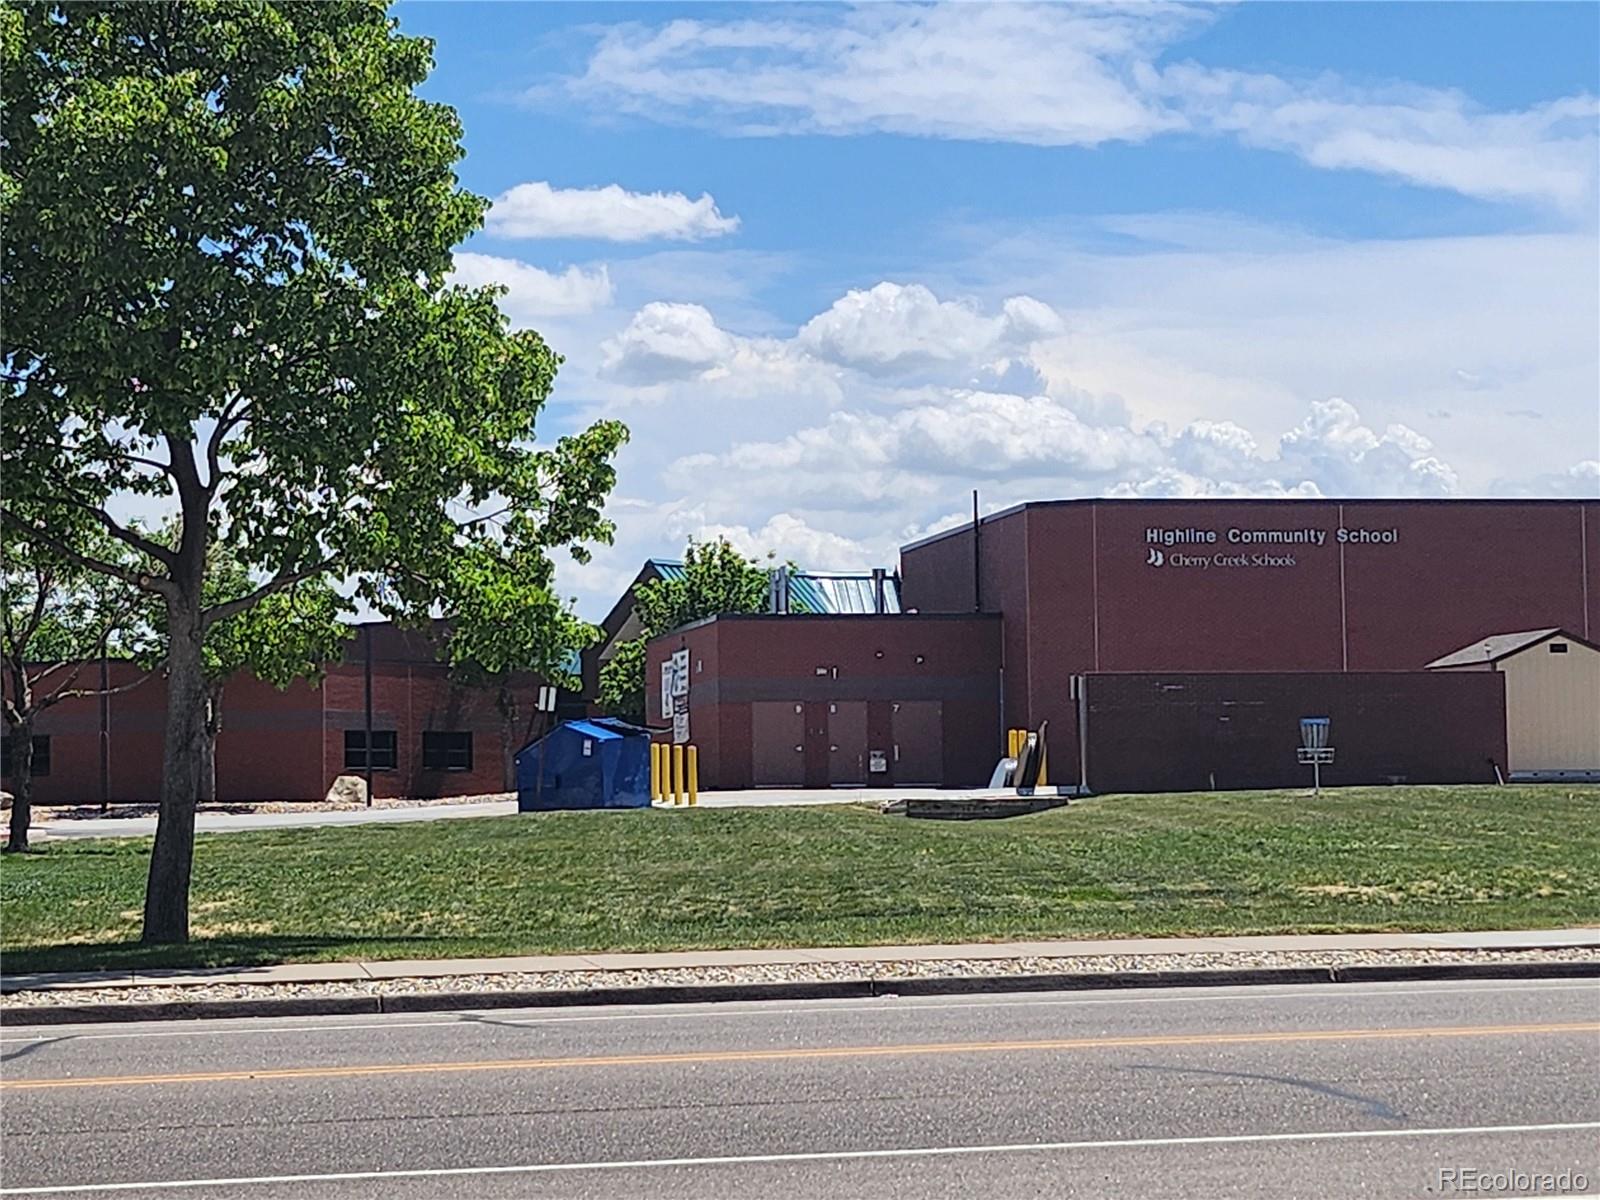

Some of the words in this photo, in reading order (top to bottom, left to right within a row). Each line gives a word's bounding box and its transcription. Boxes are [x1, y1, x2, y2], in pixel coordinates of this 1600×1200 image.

[1146, 528, 1217, 546] Highline
[1227, 528, 1326, 546] Community
[1336, 528, 1398, 544] School
[1169, 553, 1212, 570] Cherry
[1214, 553, 1249, 567] Creek
[1251, 553, 1296, 567] Schools
